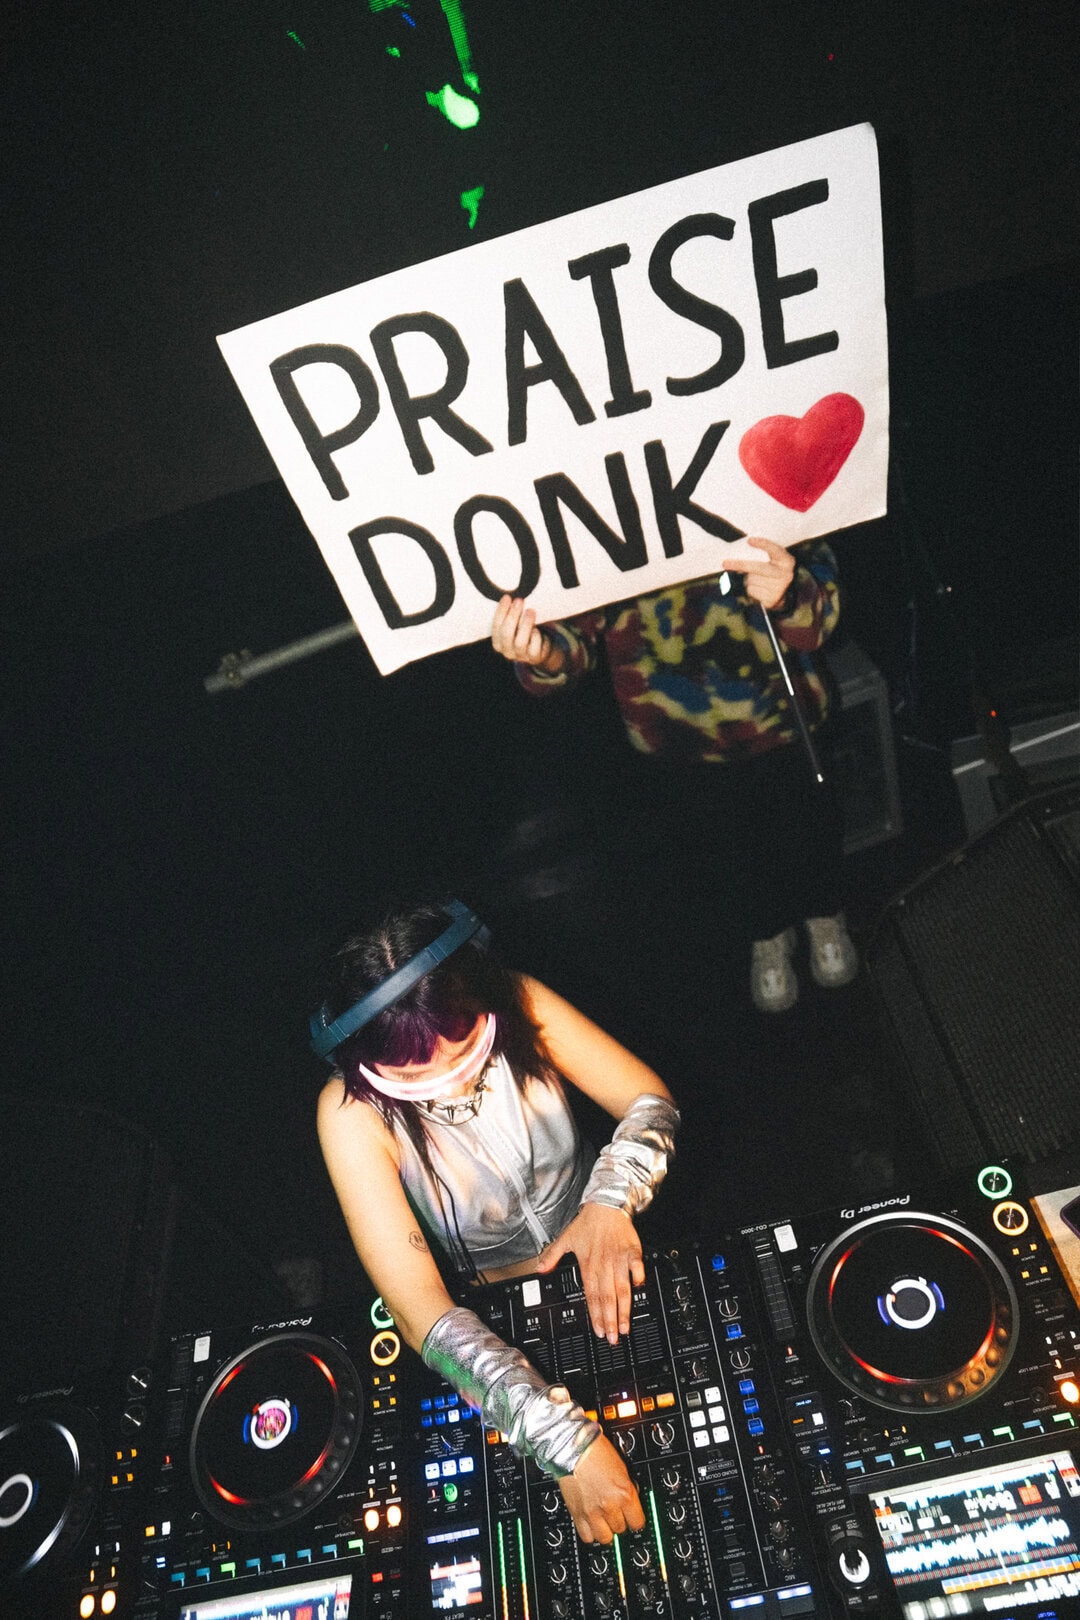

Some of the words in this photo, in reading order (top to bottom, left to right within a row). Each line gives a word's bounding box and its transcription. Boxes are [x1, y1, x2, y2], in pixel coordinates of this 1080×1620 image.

[269, 178, 839, 501] PRAISE
[348, 420, 747, 630] DONK
[857, 1195, 911, 1214] Pioneer
[840, 1207, 856, 1219] DJ
[740, 1224, 767, 1234] CDJ-3000
[655, 1600, 664, 1614] 2
[612, 1609, 621, 1620] 3
